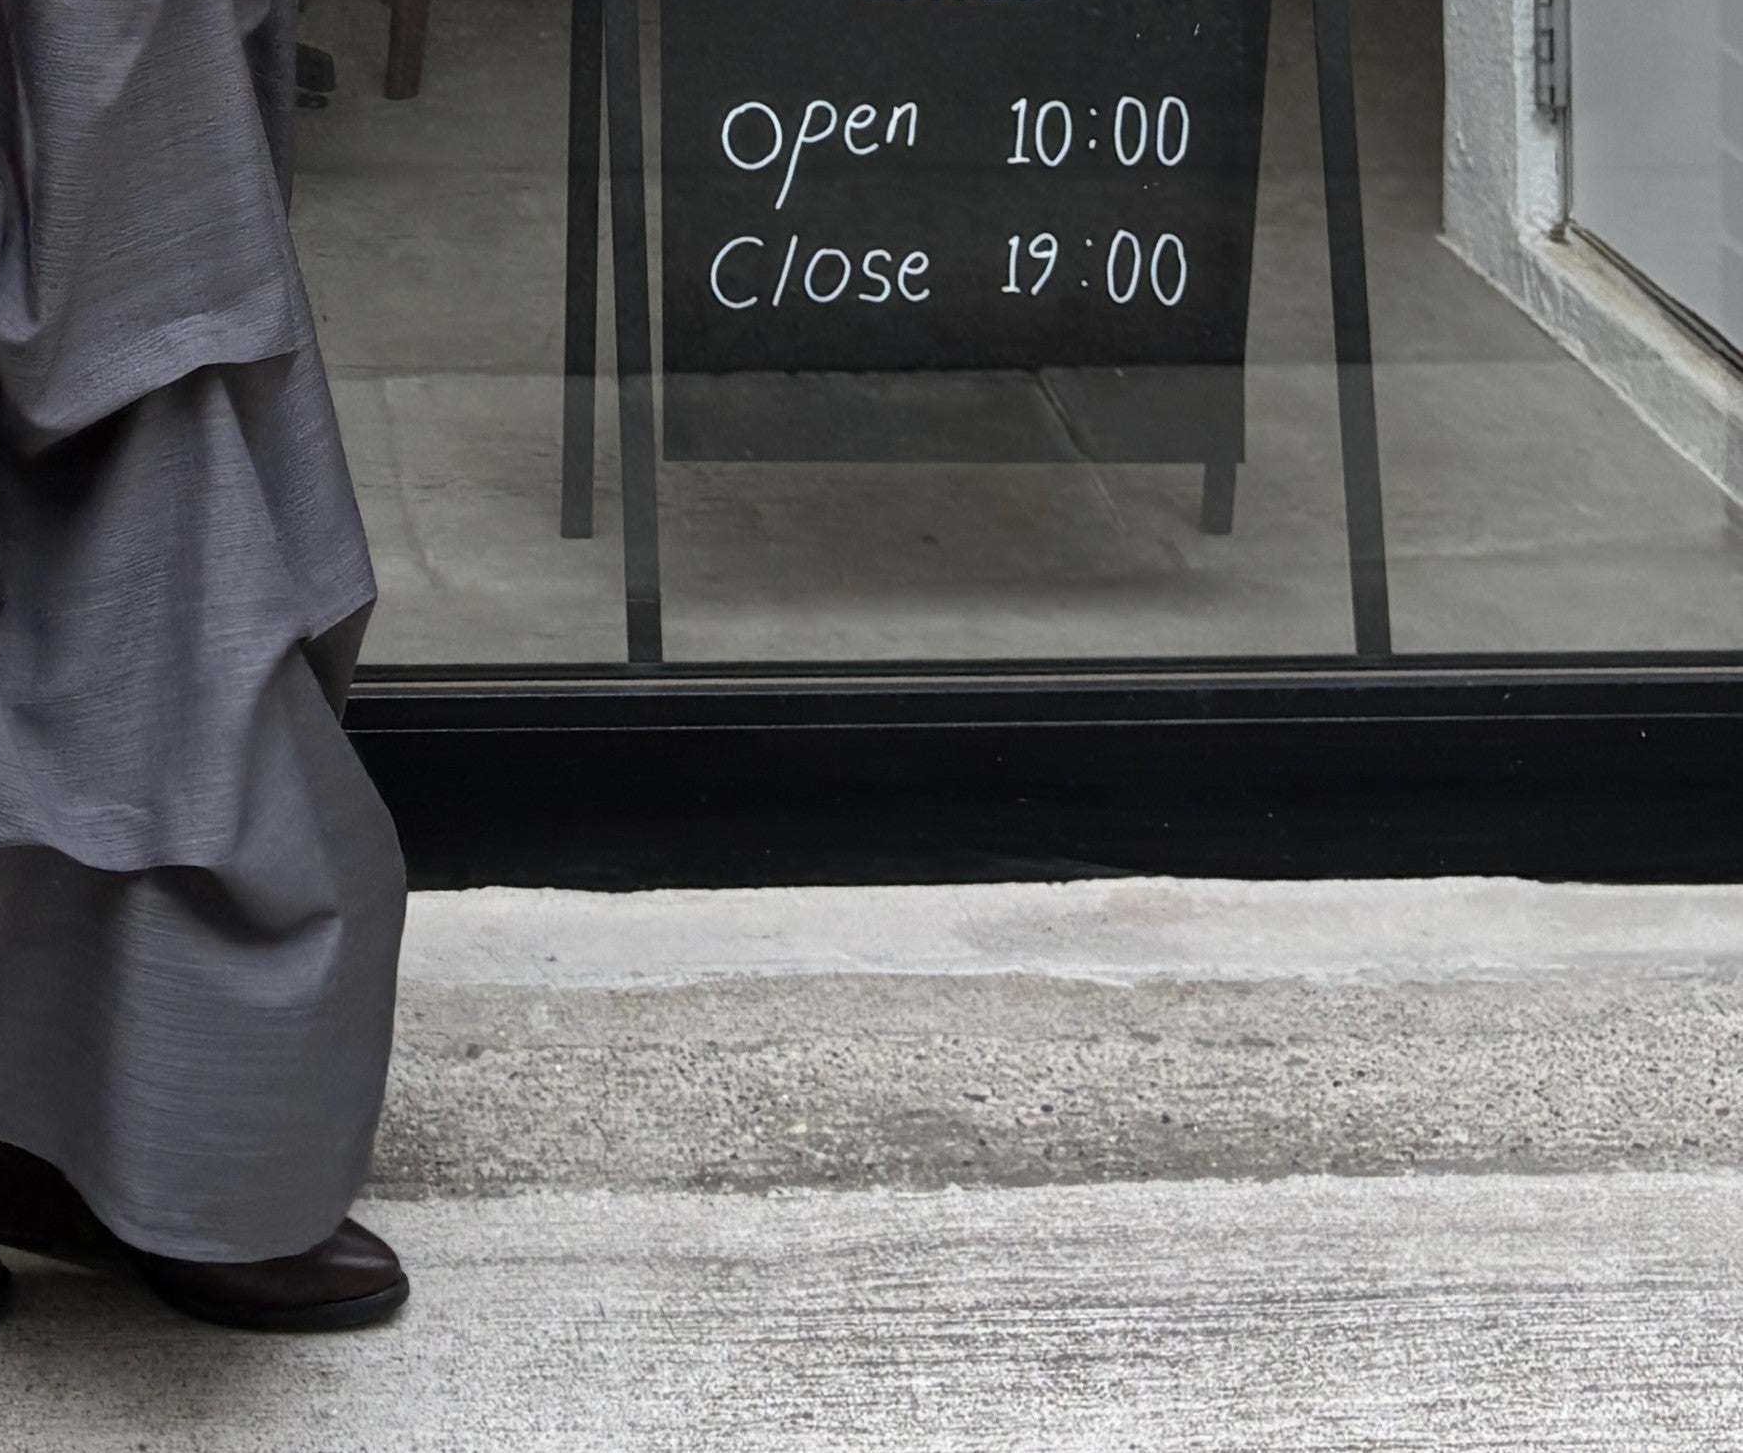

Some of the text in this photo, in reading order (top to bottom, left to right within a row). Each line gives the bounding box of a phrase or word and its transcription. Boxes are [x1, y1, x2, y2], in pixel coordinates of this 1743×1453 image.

[721, 96, 1190, 210] Open 10:00
[710, 229, 1187, 310] Close 19:00
